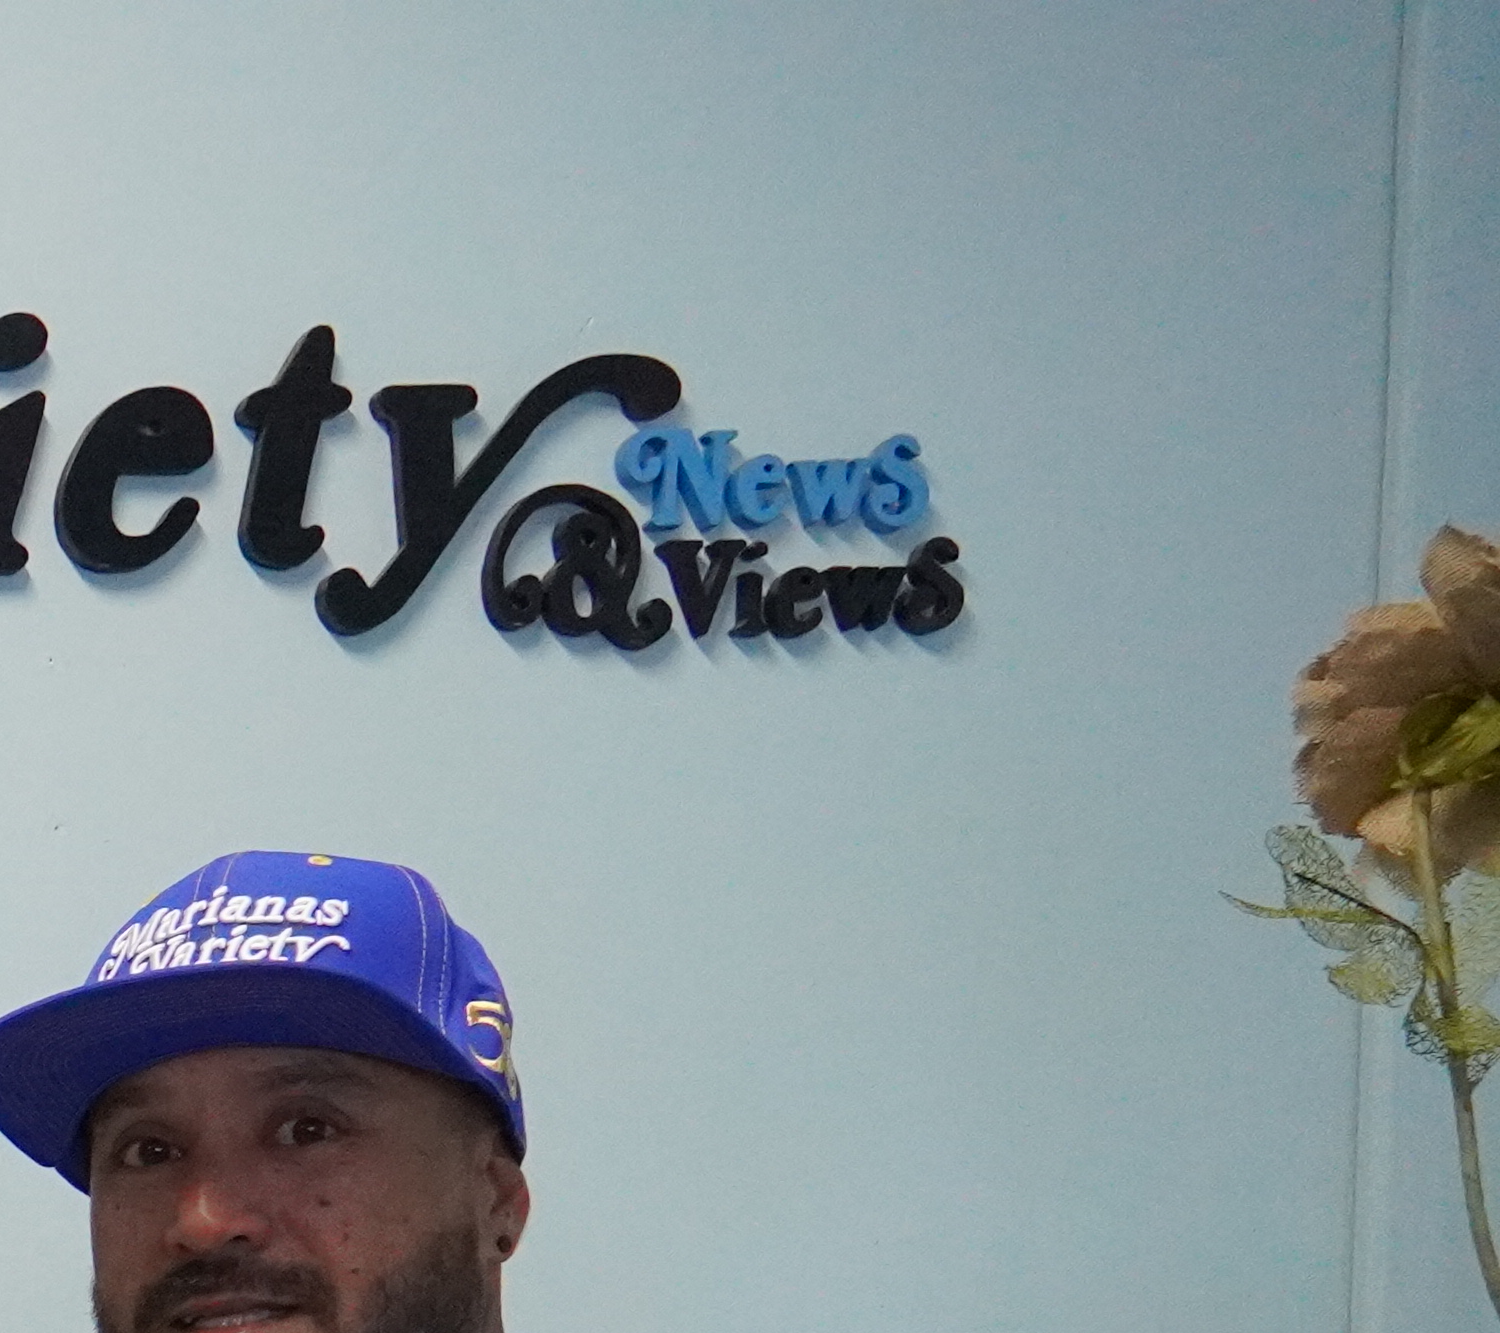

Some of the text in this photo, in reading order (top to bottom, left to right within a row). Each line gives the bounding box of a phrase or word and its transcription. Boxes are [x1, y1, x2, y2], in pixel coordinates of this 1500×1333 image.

[617, 421, 929, 538] News
[480, 485, 967, 652] & Views
[97, 885, 349, 981] Marianas
[129, 925, 350, 975] Variety
